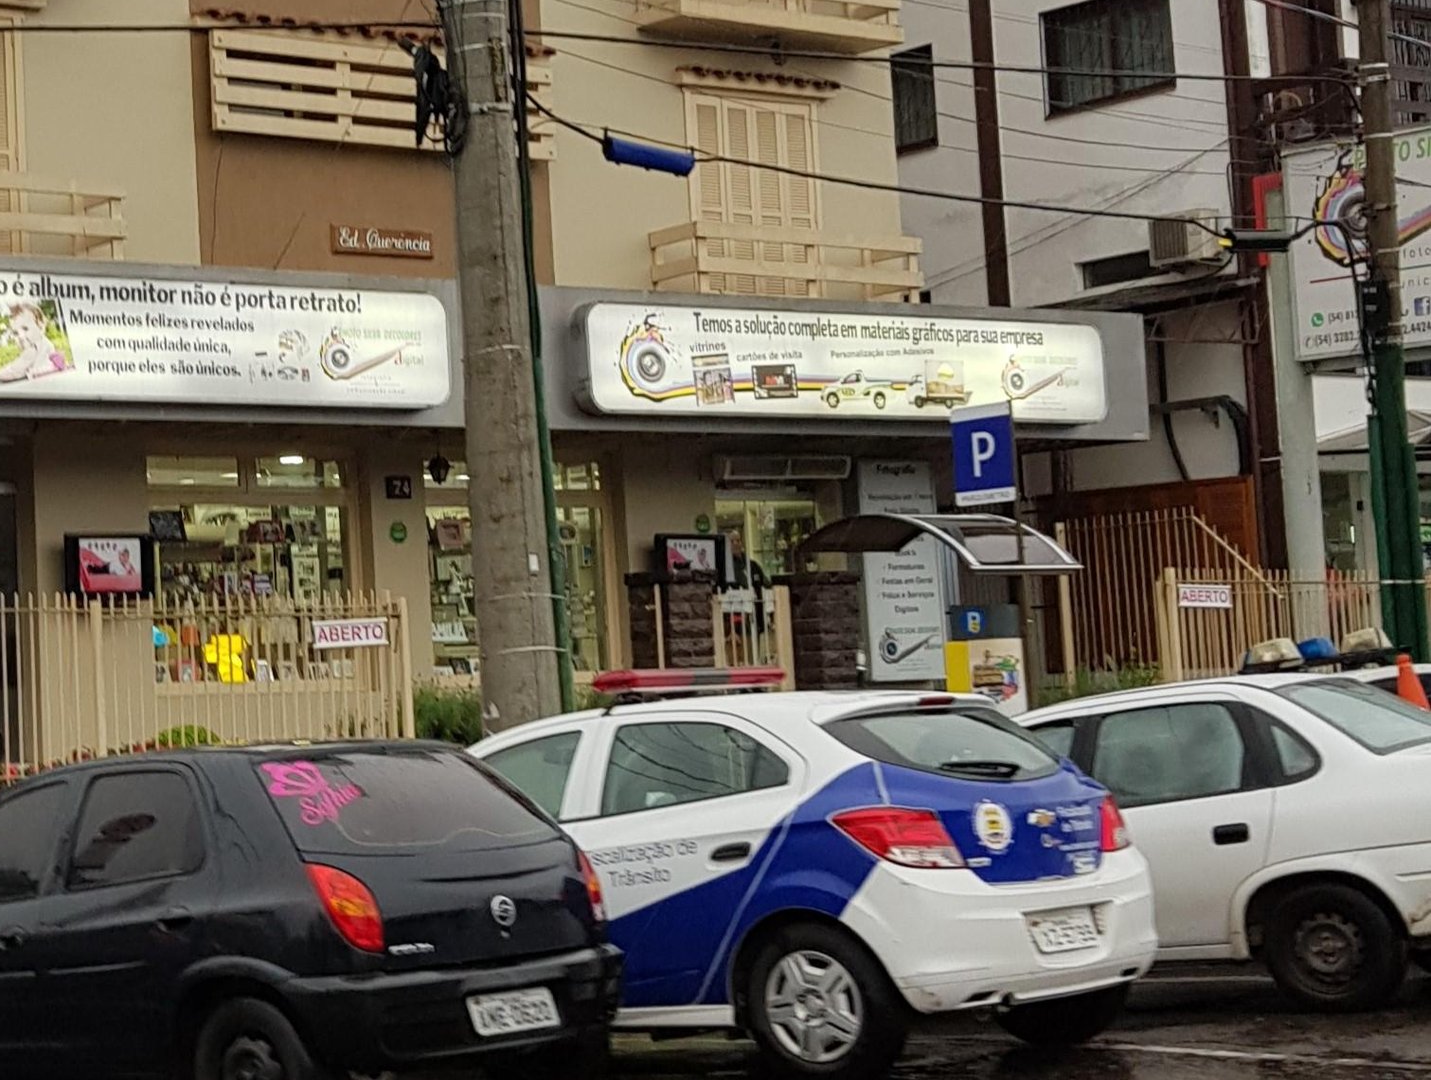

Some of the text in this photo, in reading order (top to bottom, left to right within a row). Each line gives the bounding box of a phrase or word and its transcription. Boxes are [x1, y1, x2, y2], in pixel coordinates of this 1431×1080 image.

[15, 274, 25, 297] é
[29, 274, 96, 304] album,
[99, 280, 178, 304] monitor
[181, 284, 216, 306] não
[220, 286, 232, 307] é
[235, 289, 288, 312] porta
[290, 291, 362, 313] retrato!
[69, 309, 255, 332] Momentos felizes revelados
[693, 312, 1044, 347] Temos a solução completa em materiais gráficos para sua empresa
[96, 336, 232, 357] com qualidade única,
[689, 340, 726, 353] vitrines
[736, 350, 802, 362] cartões de visita
[88, 358, 242, 377] porque eles são únicos.
[971, 431, 996, 478] P
[1182, 589, 1228, 603] ABERTO
[318, 624, 384, 643] ABERTO
[590, 842, 674, 866] scalização
